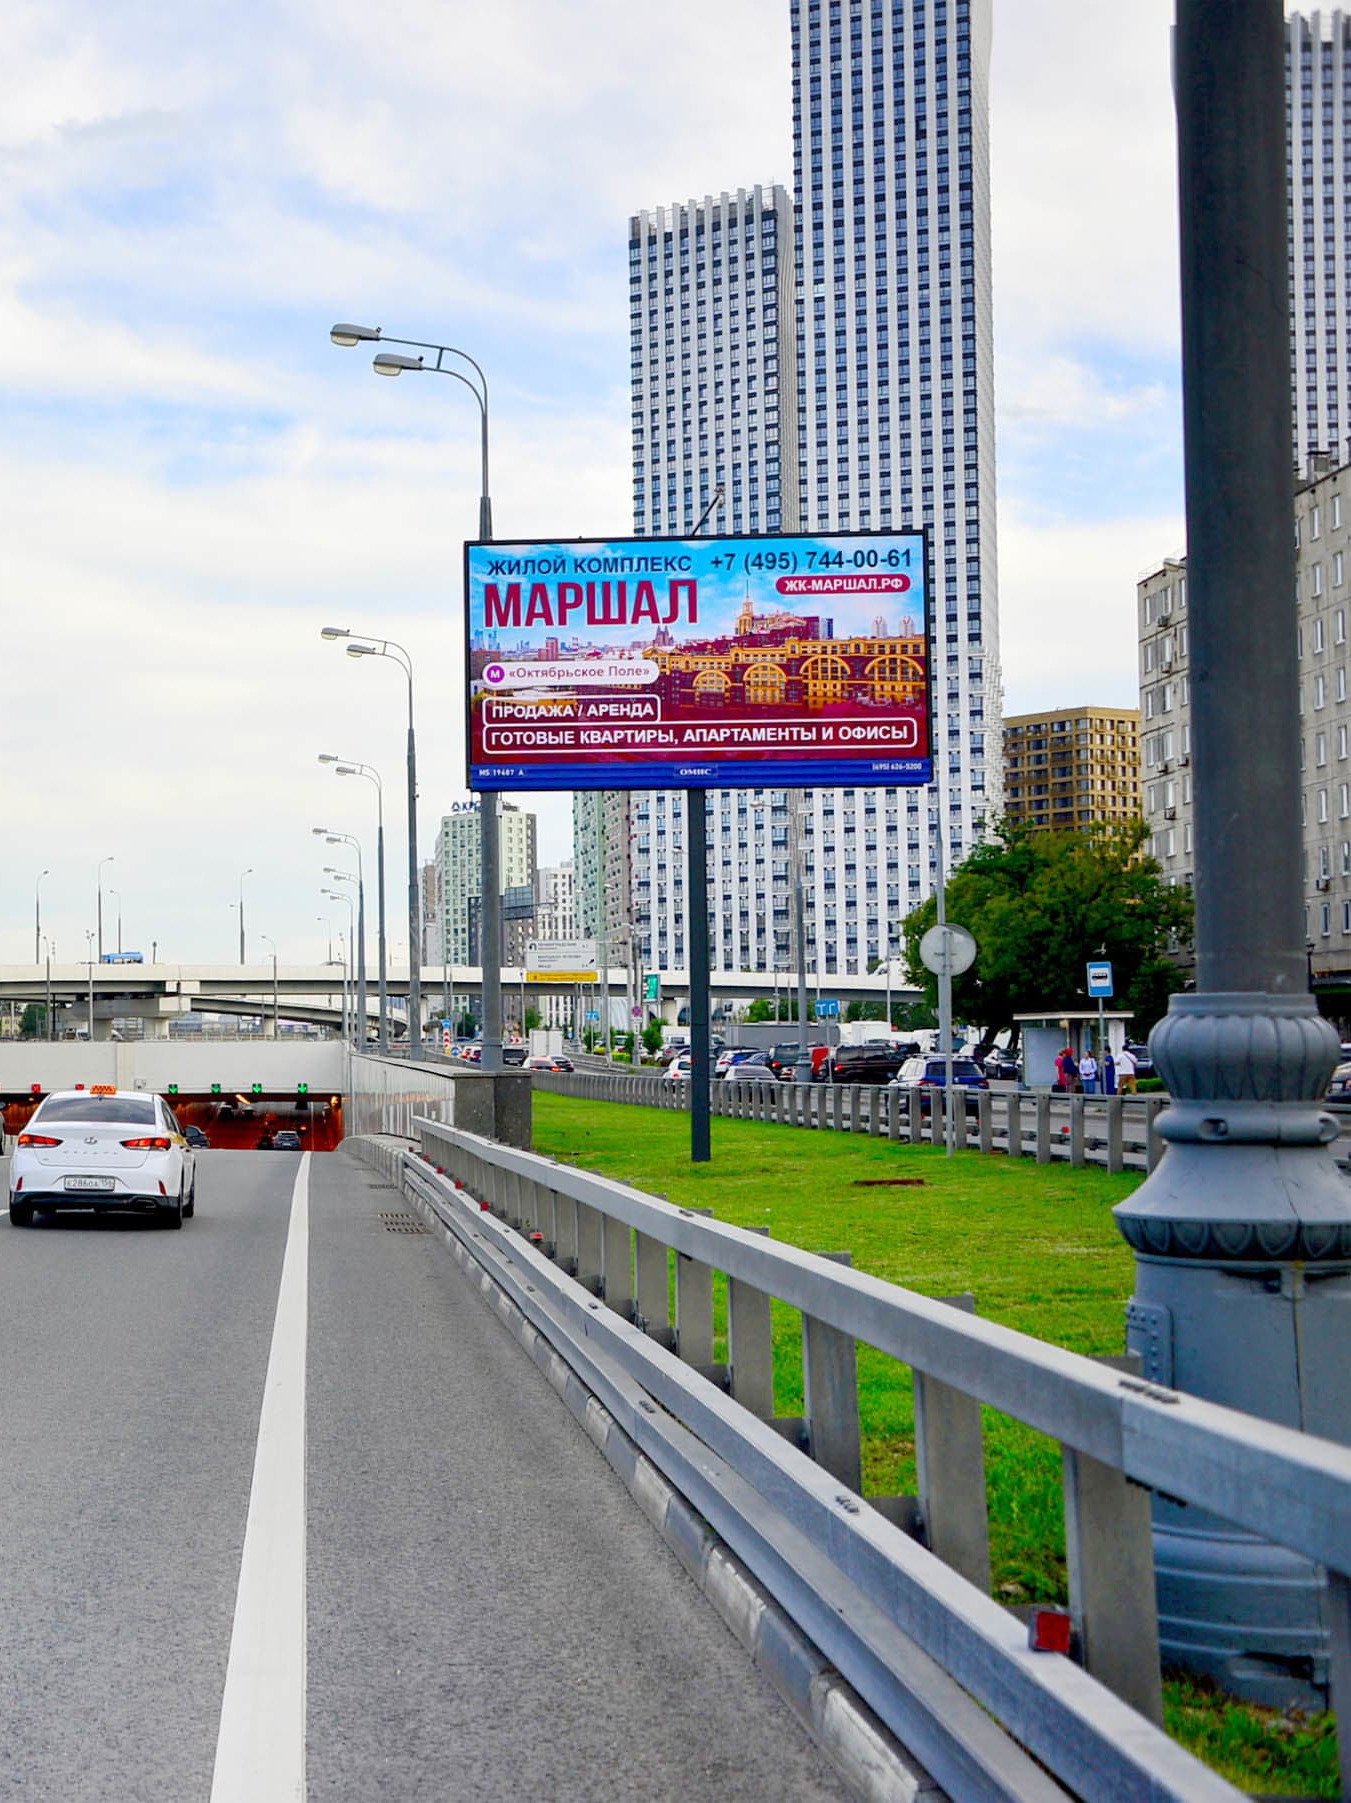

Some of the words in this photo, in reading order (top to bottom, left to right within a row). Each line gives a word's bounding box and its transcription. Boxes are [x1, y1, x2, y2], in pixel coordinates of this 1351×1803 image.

[487, 555, 567, 576] ЖИЛОЙ
[573, 555, 693, 574] КОМПЛЕКС
[710, 553, 736, 571] +7
[744, 551, 799, 575] (495)
[805, 548, 912, 570] 744-00-61
[783, 577, 904, 592] ЖК-МАРШАЛ.РФ
[483, 578, 698, 628] МАРШАЛ
[508, 666, 604, 681] «Октябрьское
[607, 665, 651, 678] Поле»
[492, 704, 575, 720] ПРОДАЖА
[586, 703, 655, 718] АРЕНДА
[491, 730, 576, 745] ГОТОВЫЕ
[579, 729, 679, 745] КВАРТИРЫ,
[682, 727, 816, 743] АПАРТАМЕНТЫ
[821, 726, 834, 741] И
[838, 725, 908, 740] ОФИСЫ
